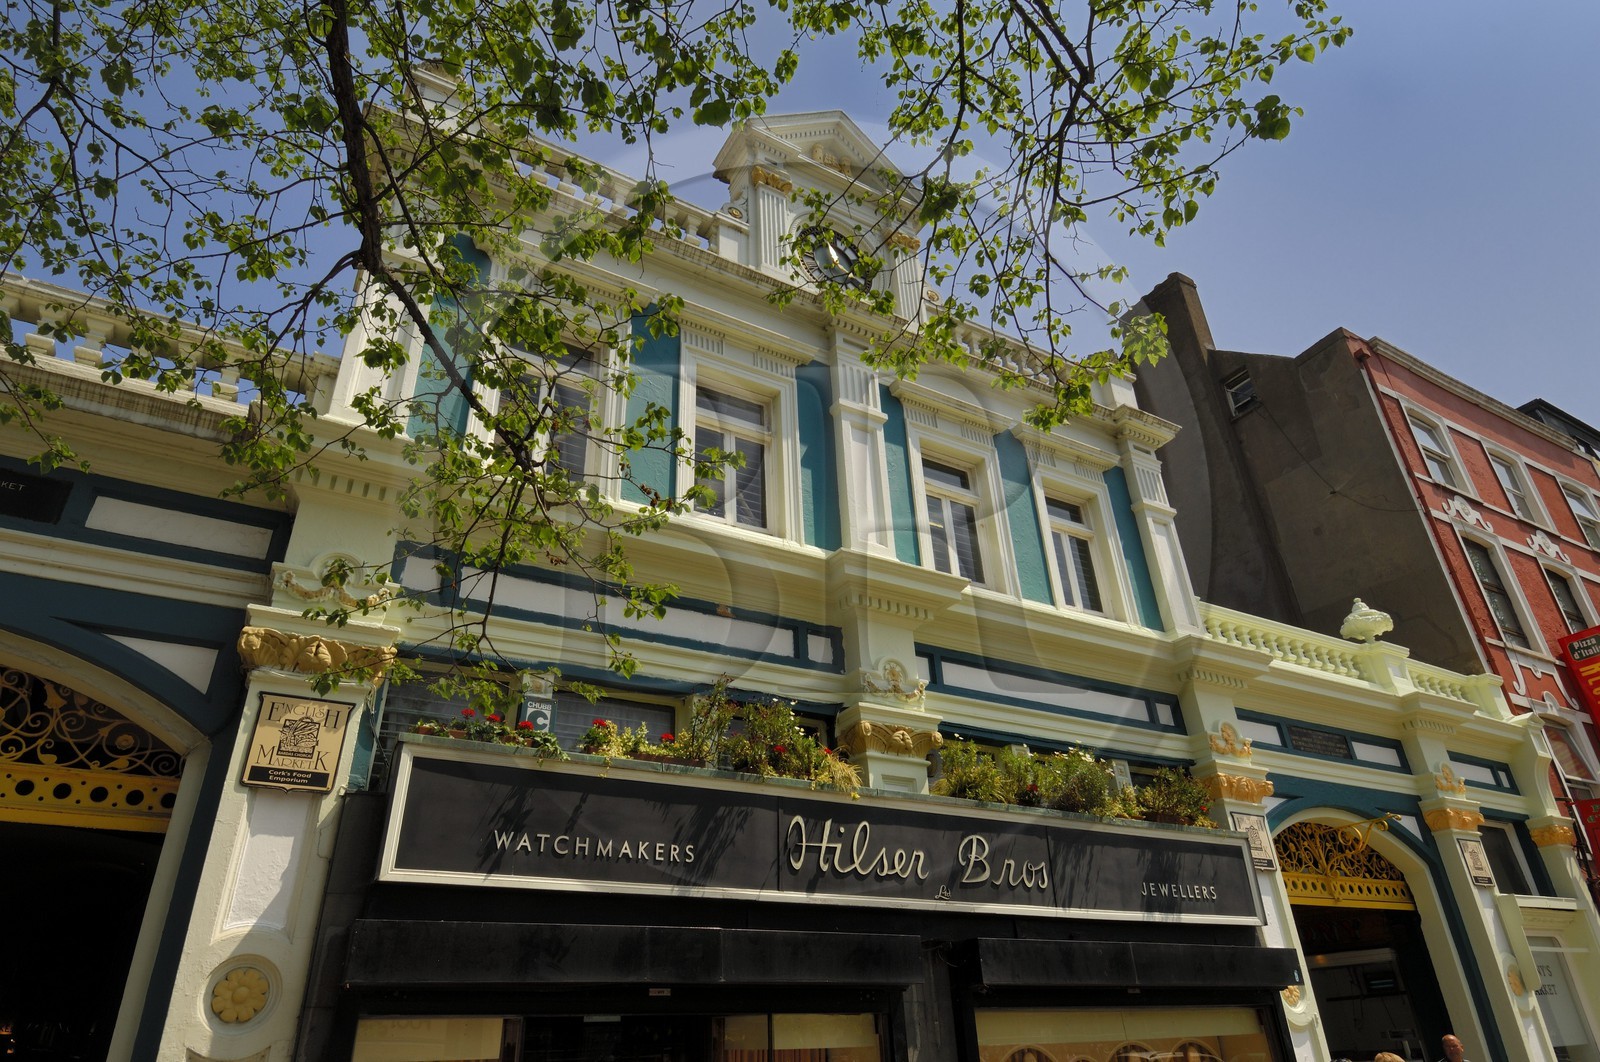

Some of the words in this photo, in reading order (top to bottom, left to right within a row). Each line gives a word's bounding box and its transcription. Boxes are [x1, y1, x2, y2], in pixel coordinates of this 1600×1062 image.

[1573, 638, 1597, 649] Pizza
[1574, 645, 1600, 660] d'Itali
[527, 701, 552, 710] CHUBB
[266, 702, 341, 728] ENGLISH
[269, 775, 308, 783] Emporium
[494, 830, 695, 863] WATCHMAKERS
[788, 815, 929, 880] Hilser
[958, 835, 1049, 889] Bros
[1141, 882, 1217, 899] JEWELLERS
